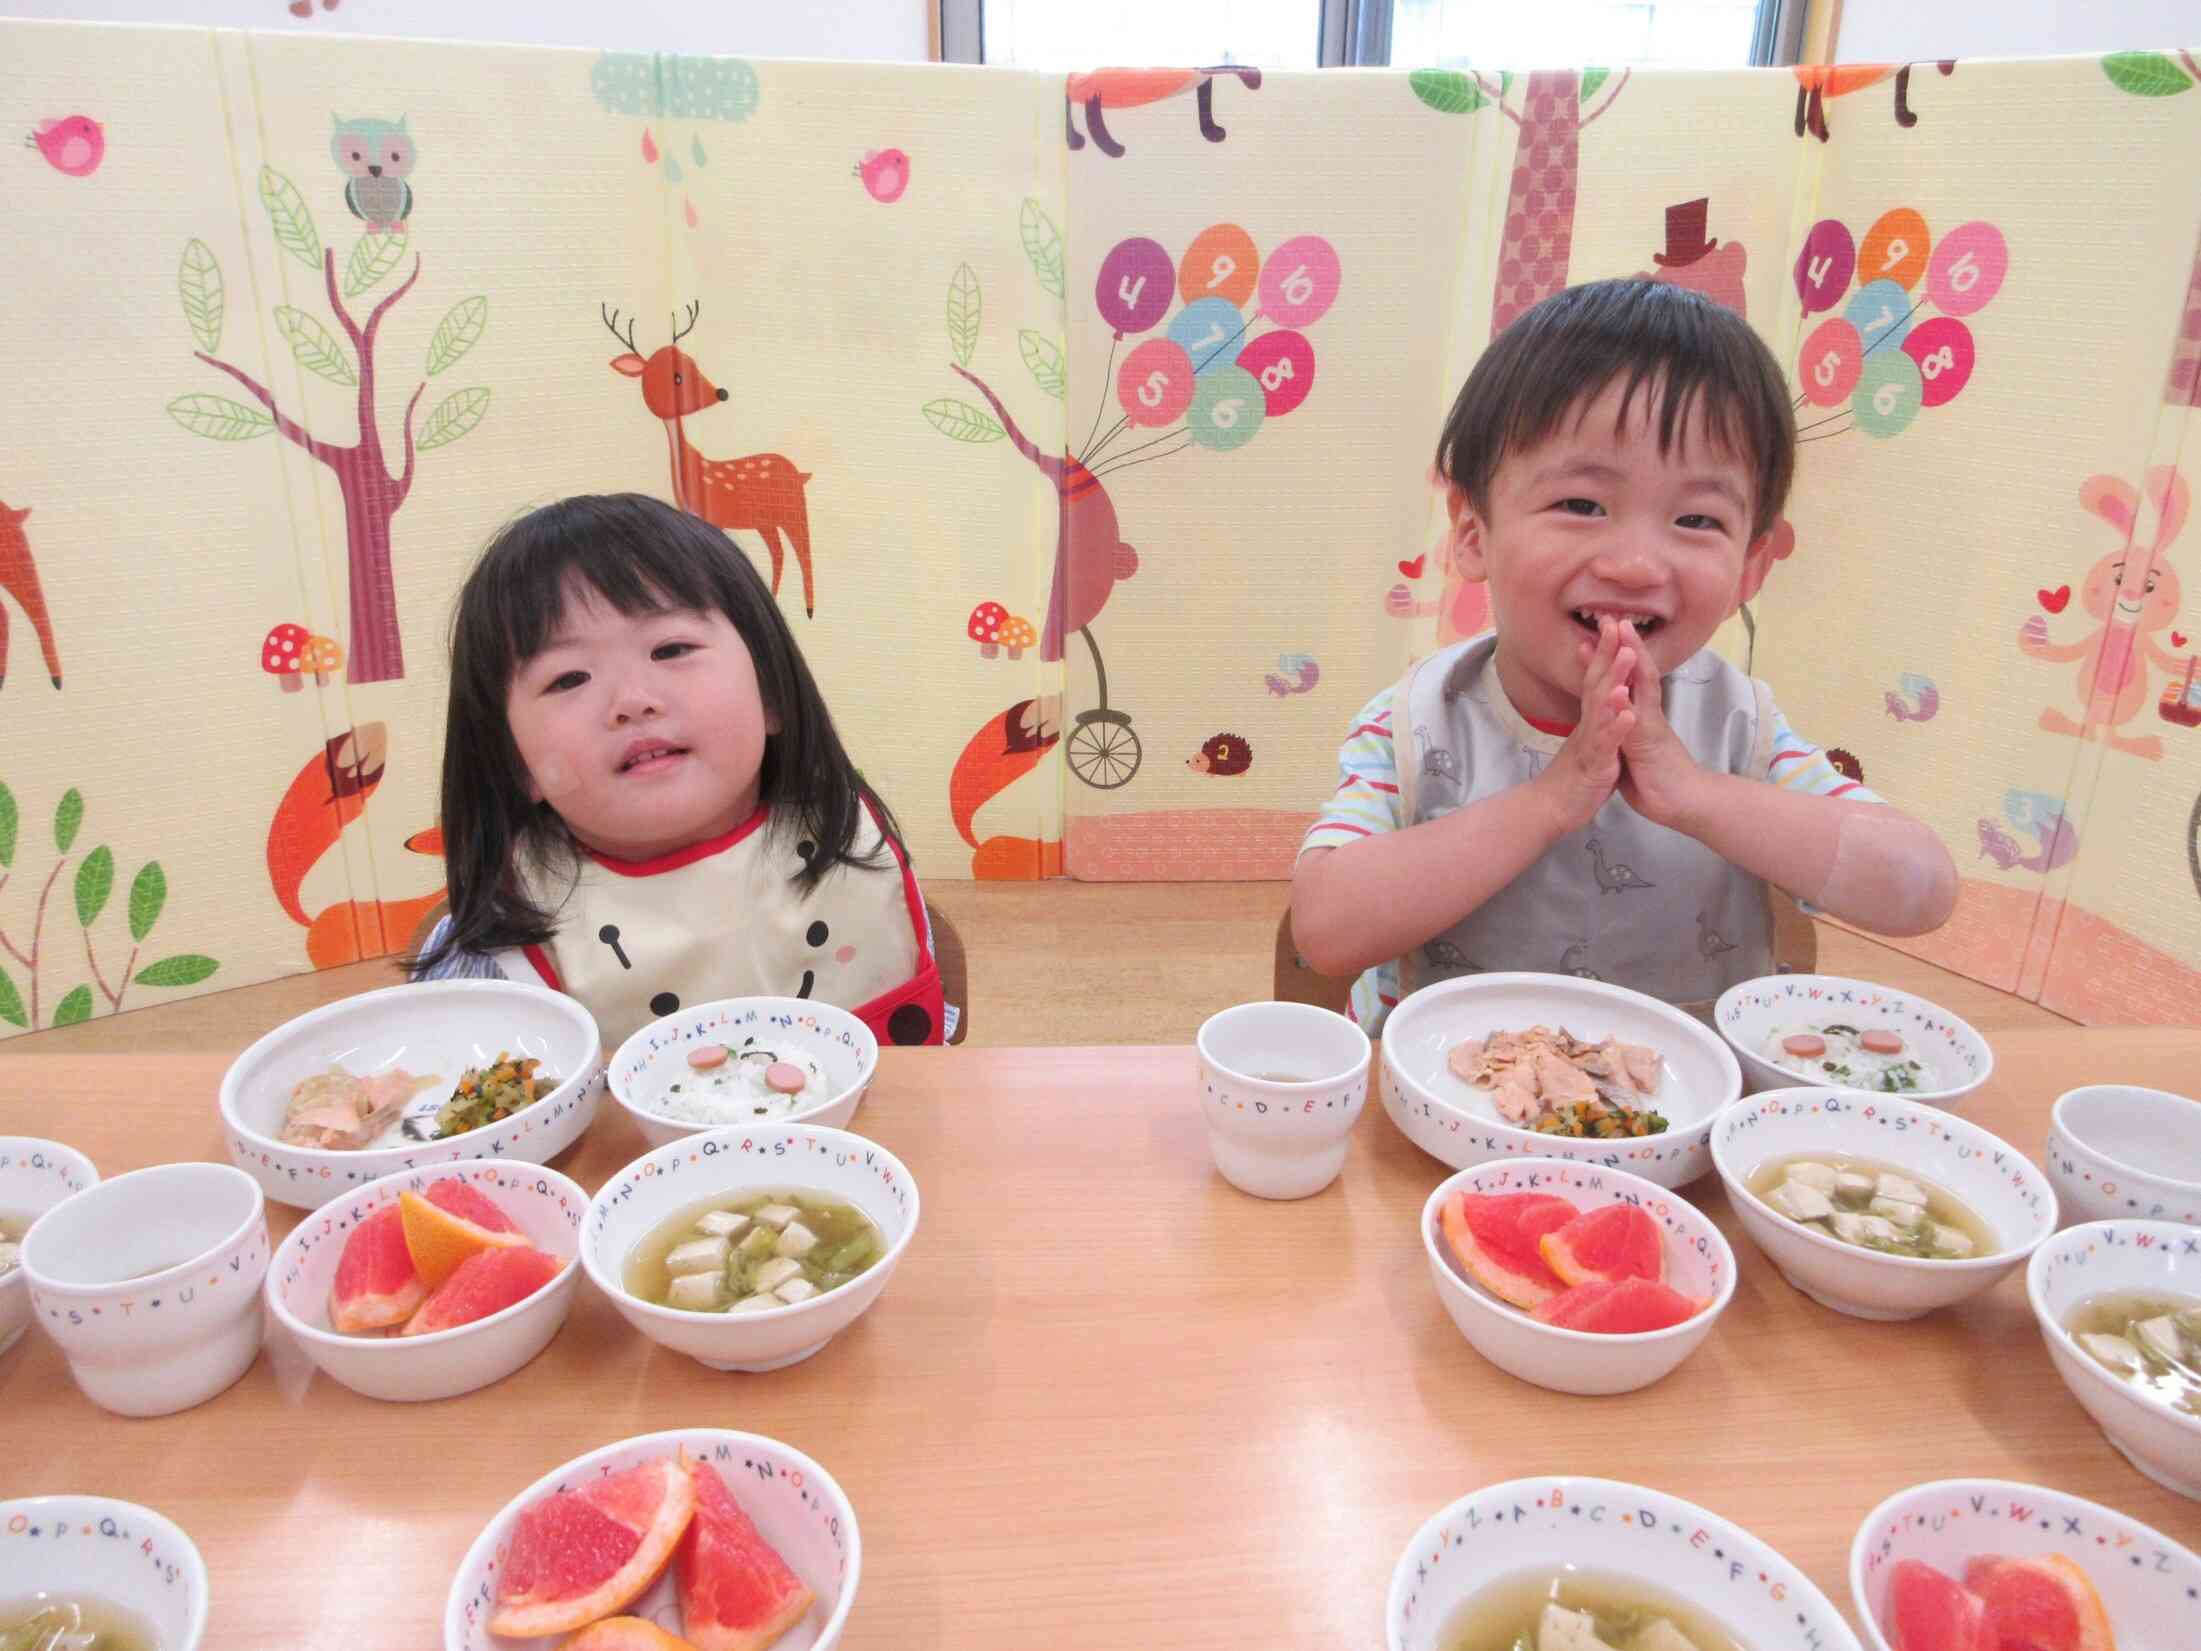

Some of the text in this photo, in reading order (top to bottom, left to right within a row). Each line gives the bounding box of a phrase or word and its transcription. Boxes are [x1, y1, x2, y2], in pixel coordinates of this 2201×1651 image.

[1881, 239, 1909, 272] 9
[1206, 256, 1236, 288] 9
[1807, 256, 1832, 288] 4
[1119, 275, 1147, 310] 4
[1261, 357, 1294, 390] 8
[1814, 351, 1840, 386] 5
[1921, 346, 1953, 379] 8
[1137, 371, 1168, 406] 5
[1873, 383, 1905, 415] 6
[1211, 399, 1247, 428] 6
[1217, 744, 1229, 760] 2
[1825, 1098, 1841, 1112] Q
[1957, 1144, 1971, 1159] U
[31, 1153, 46, 1169] Q
[702, 1141, 720, 1156] Q
[1604, 1153, 1620, 1168] N
[410, 1176, 424, 1191] M
[536, 1179, 549, 1196] Q
[1696, 1237, 1708, 1256] Q
[2136, 1233, 2156, 1249] W
[2184, 1239, 2199, 1254] X
[69, 1310, 83, 1325] S
[179, 1287, 194, 1303] U
[716, 1444, 731, 1461] M
[758, 1461, 774, 1480] N
[791, 1471, 804, 1488] O
[8, 1512, 28, 1534] O
[56, 1521, 69, 1538] P
[99, 1517, 120, 1538] Q
[1932, 1515, 1945, 1532] U
[1971, 1495, 1985, 1512] V
[2009, 1502, 2034, 1521] W
[2063, 1516, 2082, 1535] X
[2153, 1550, 2173, 1573] Z
[1513, 1503, 1528, 1524] A
[1552, 1489, 1564, 1509] B
[1590, 1504, 1607, 1522] C
[1639, 1509, 1656, 1528] D
[1690, 1528, 1710, 1549] E
[1730, 1561, 1744, 1581] F
[1769, 1582, 1788, 1601] G
